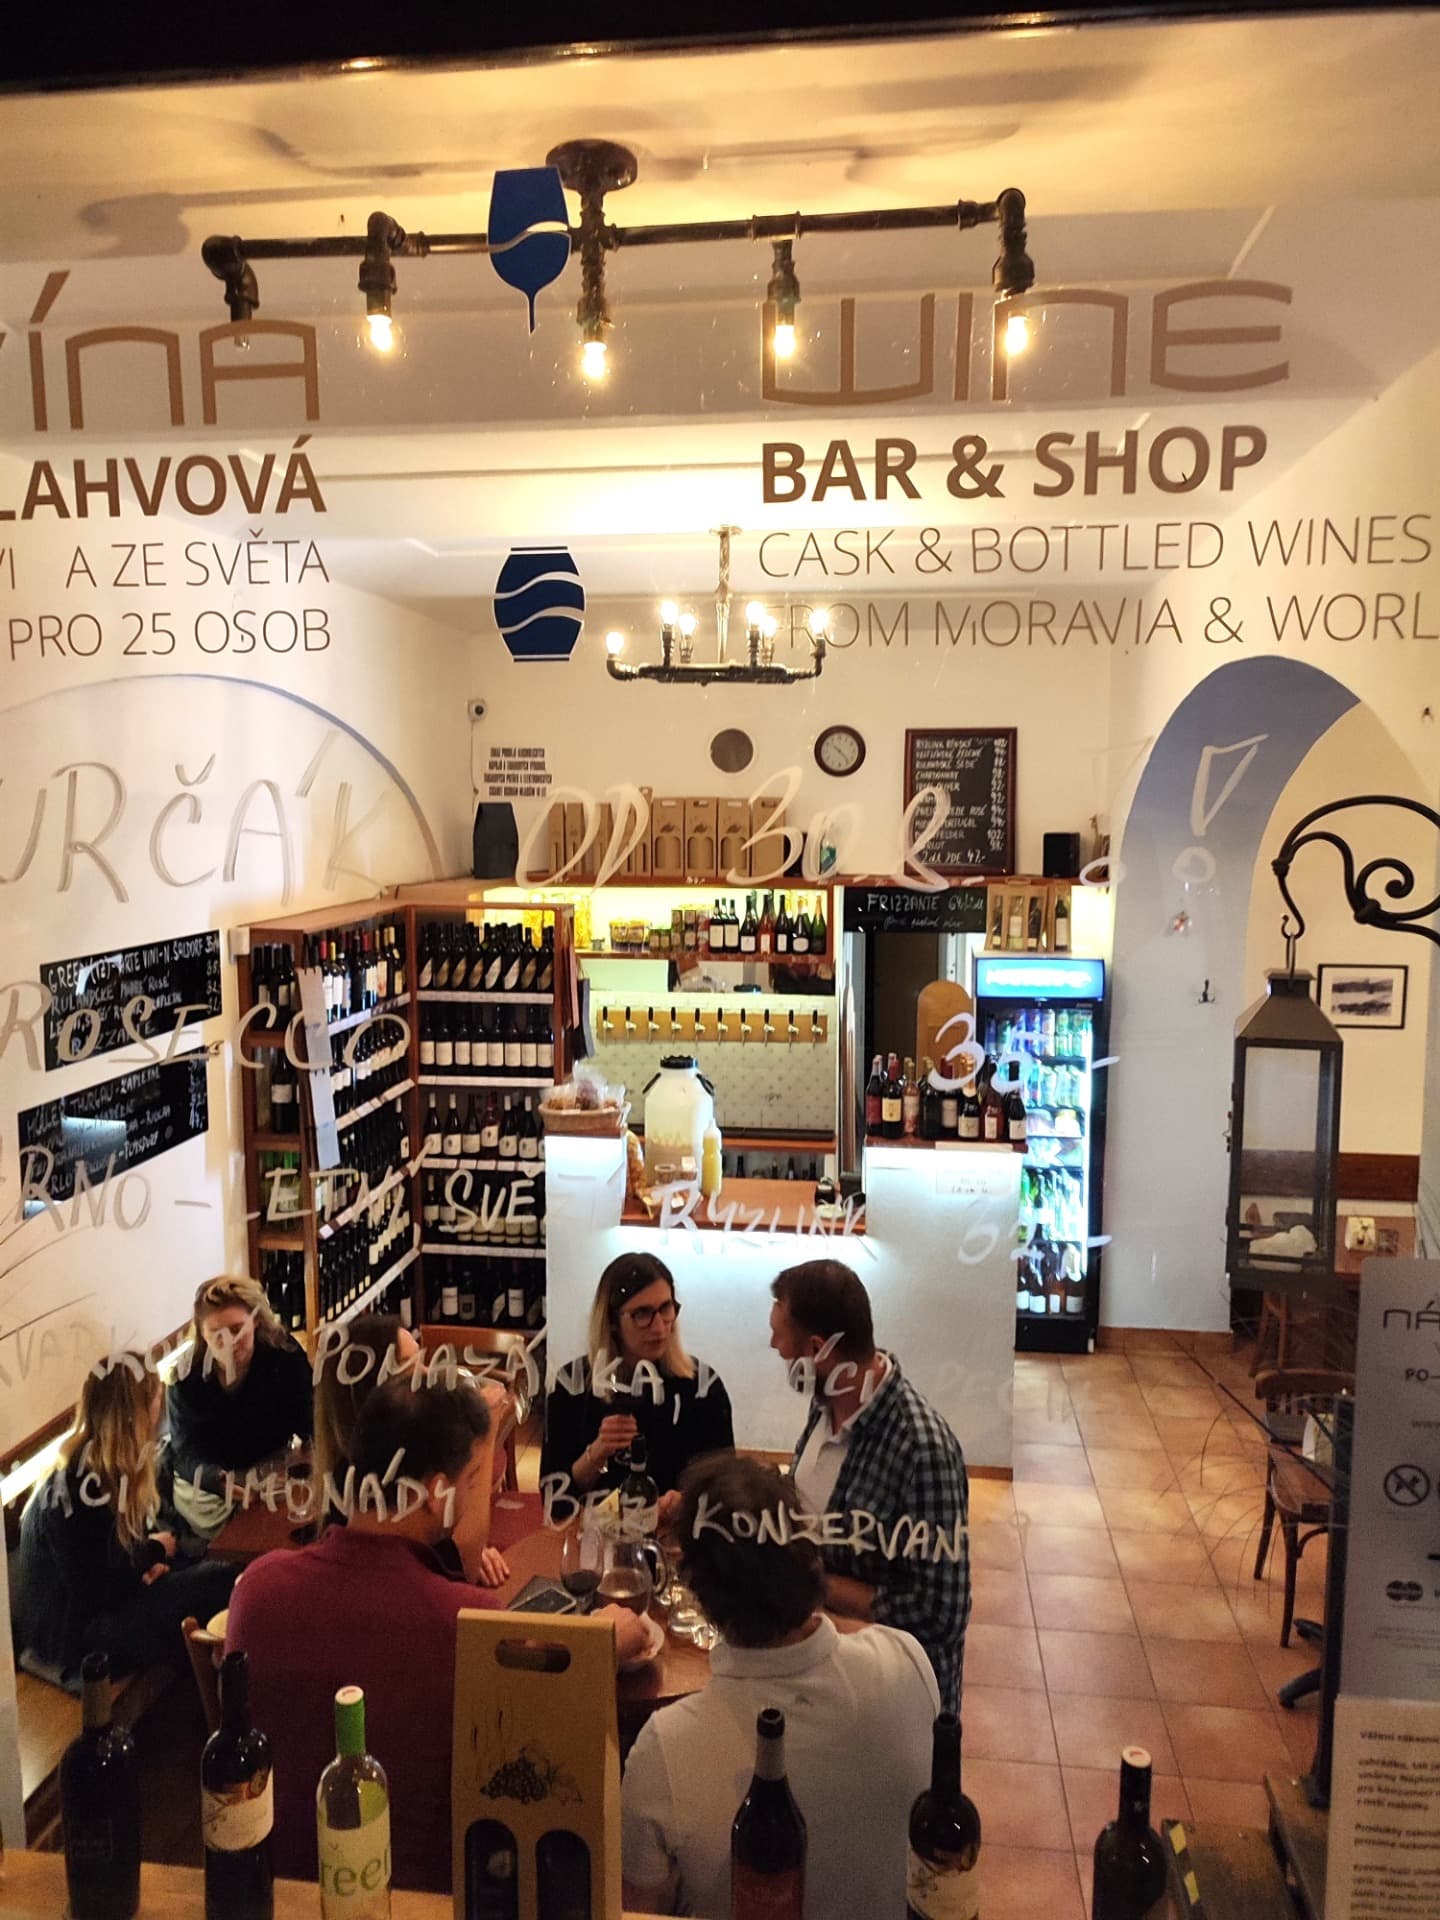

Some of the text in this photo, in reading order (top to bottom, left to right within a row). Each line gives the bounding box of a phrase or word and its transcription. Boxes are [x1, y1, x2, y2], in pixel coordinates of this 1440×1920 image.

[0, 270, 320, 431] ÍNA
[763, 425, 1268, 504] BAR & SHOP
[112, 541, 165, 588] ZE
[184, 528, 330, 586] SVĚTA
[758, 513, 1433, 578] CASK & BOTTLED WINES
[9, 608, 331, 661] PRO 25 OSOB
[935, 599, 1184, 648] MORAVIA
[1205, 596, 1244, 644] &
[867, 893, 940, 912] FRIZZANTE
